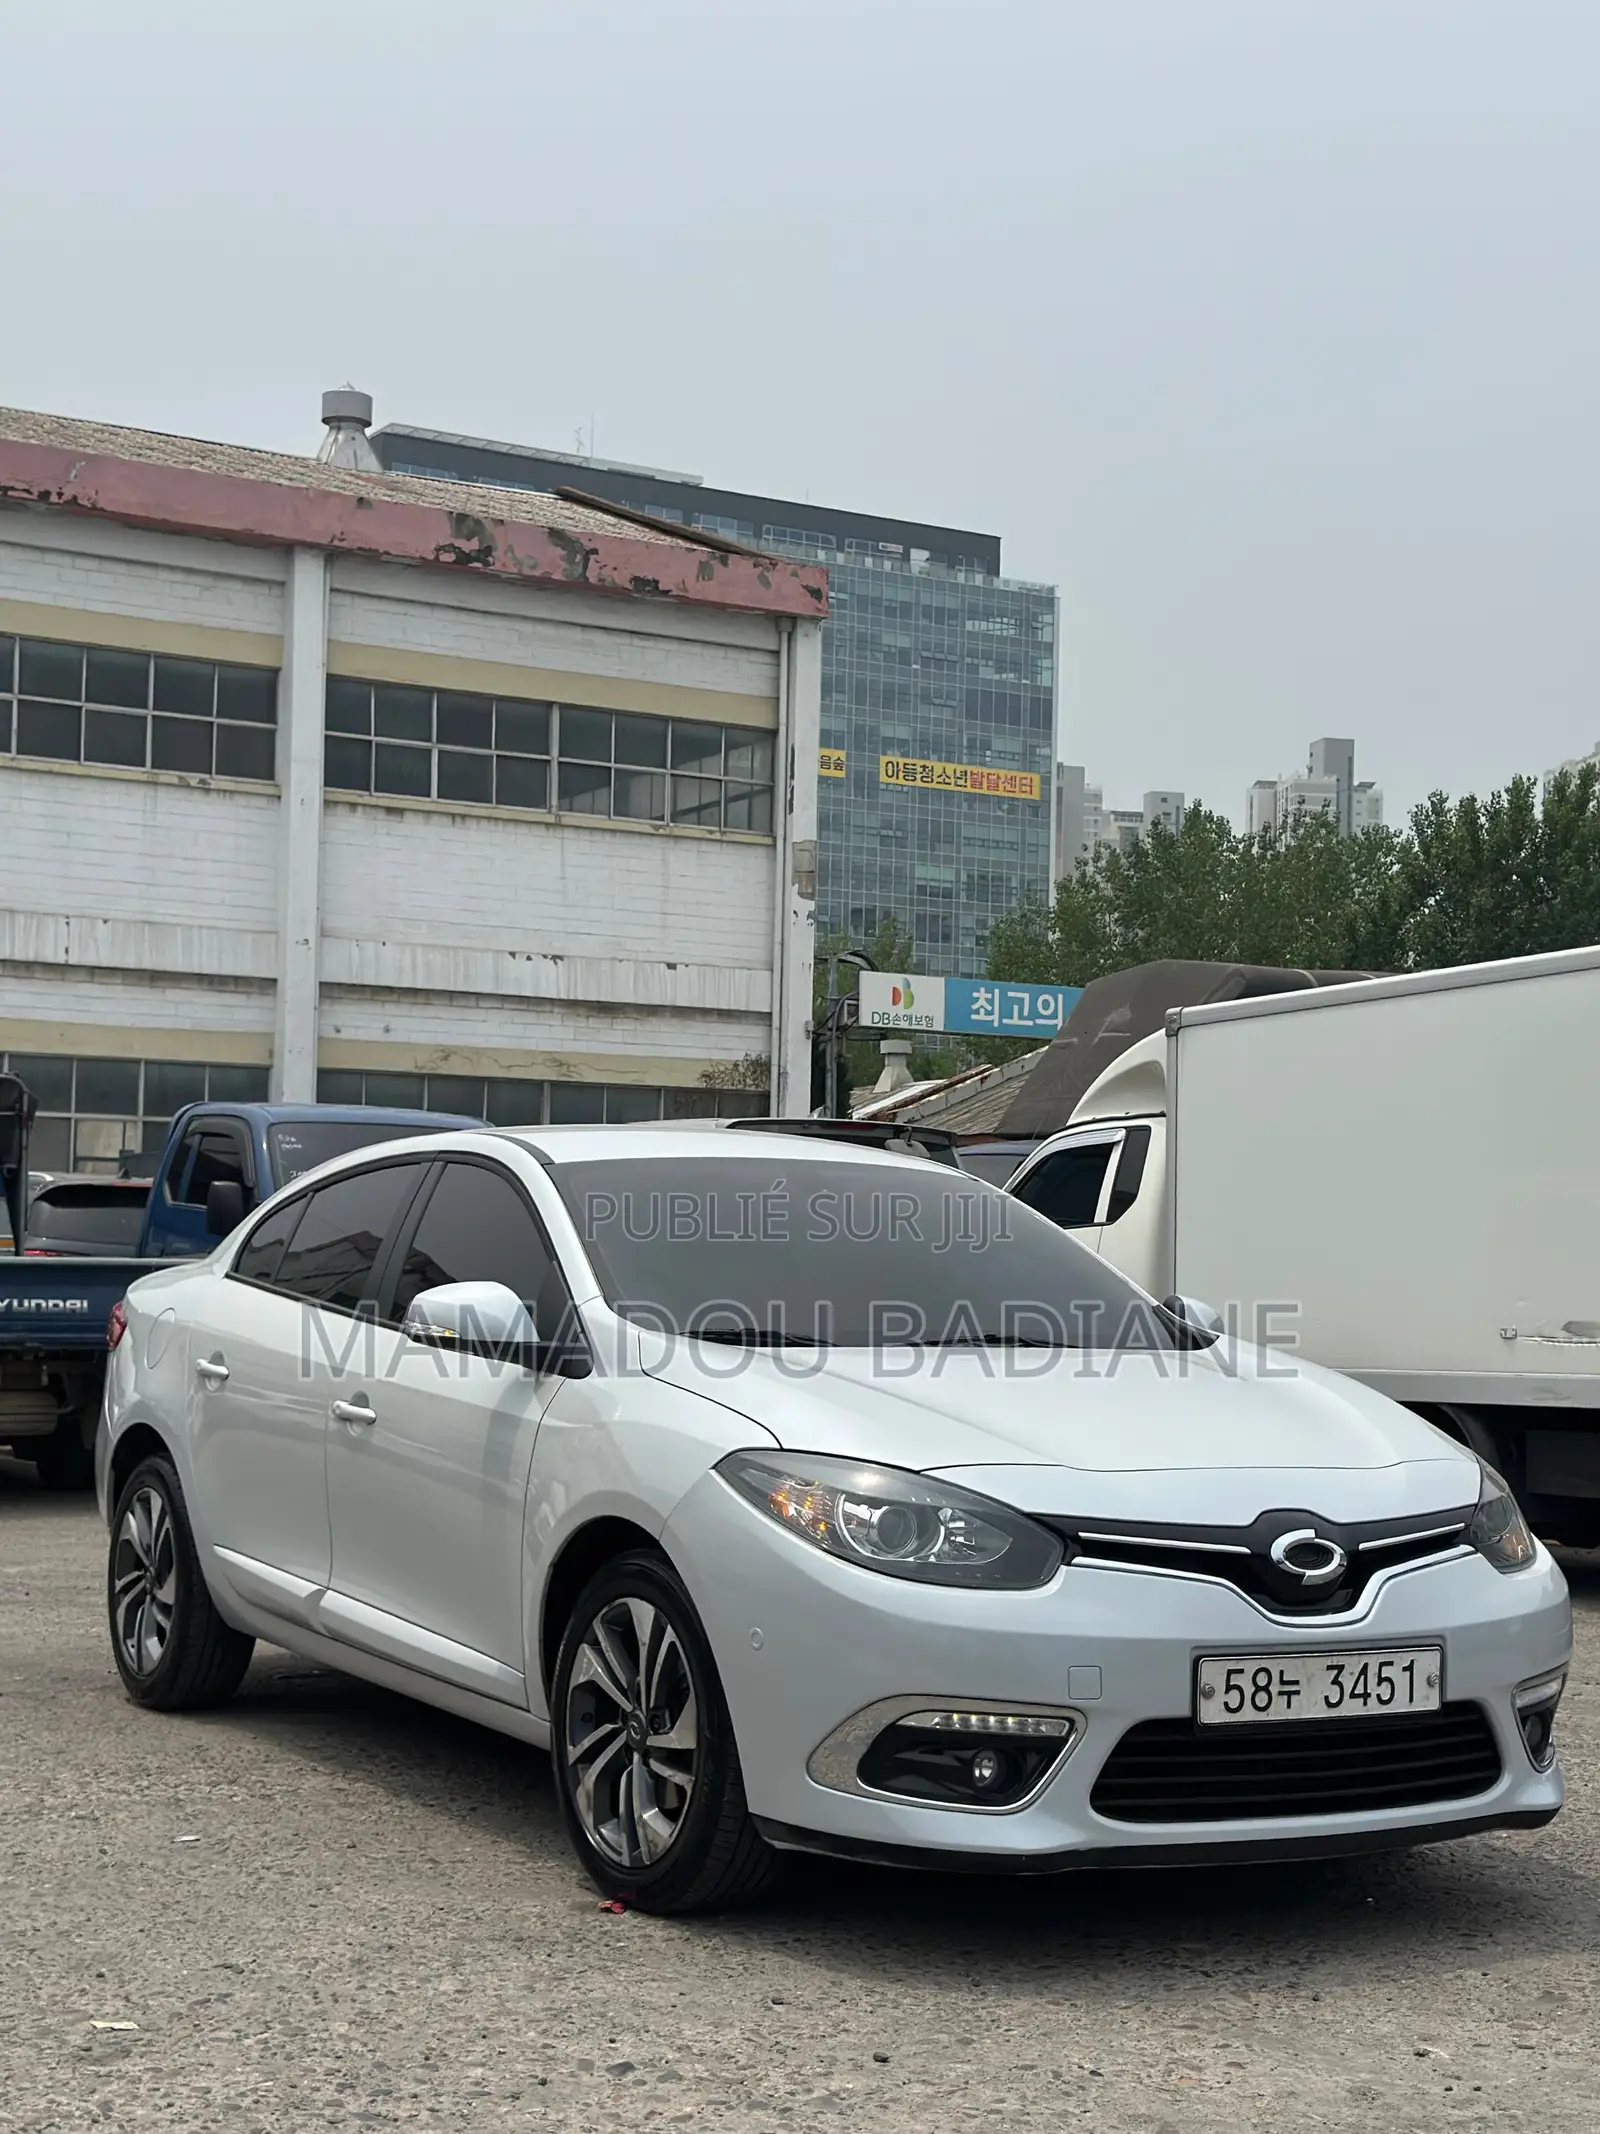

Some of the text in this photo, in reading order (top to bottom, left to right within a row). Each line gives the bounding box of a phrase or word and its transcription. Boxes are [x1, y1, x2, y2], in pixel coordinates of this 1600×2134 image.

[970, 986, 1064, 1030] 최고의
[1223, 1658, 1417, 1714] 58누 3451
